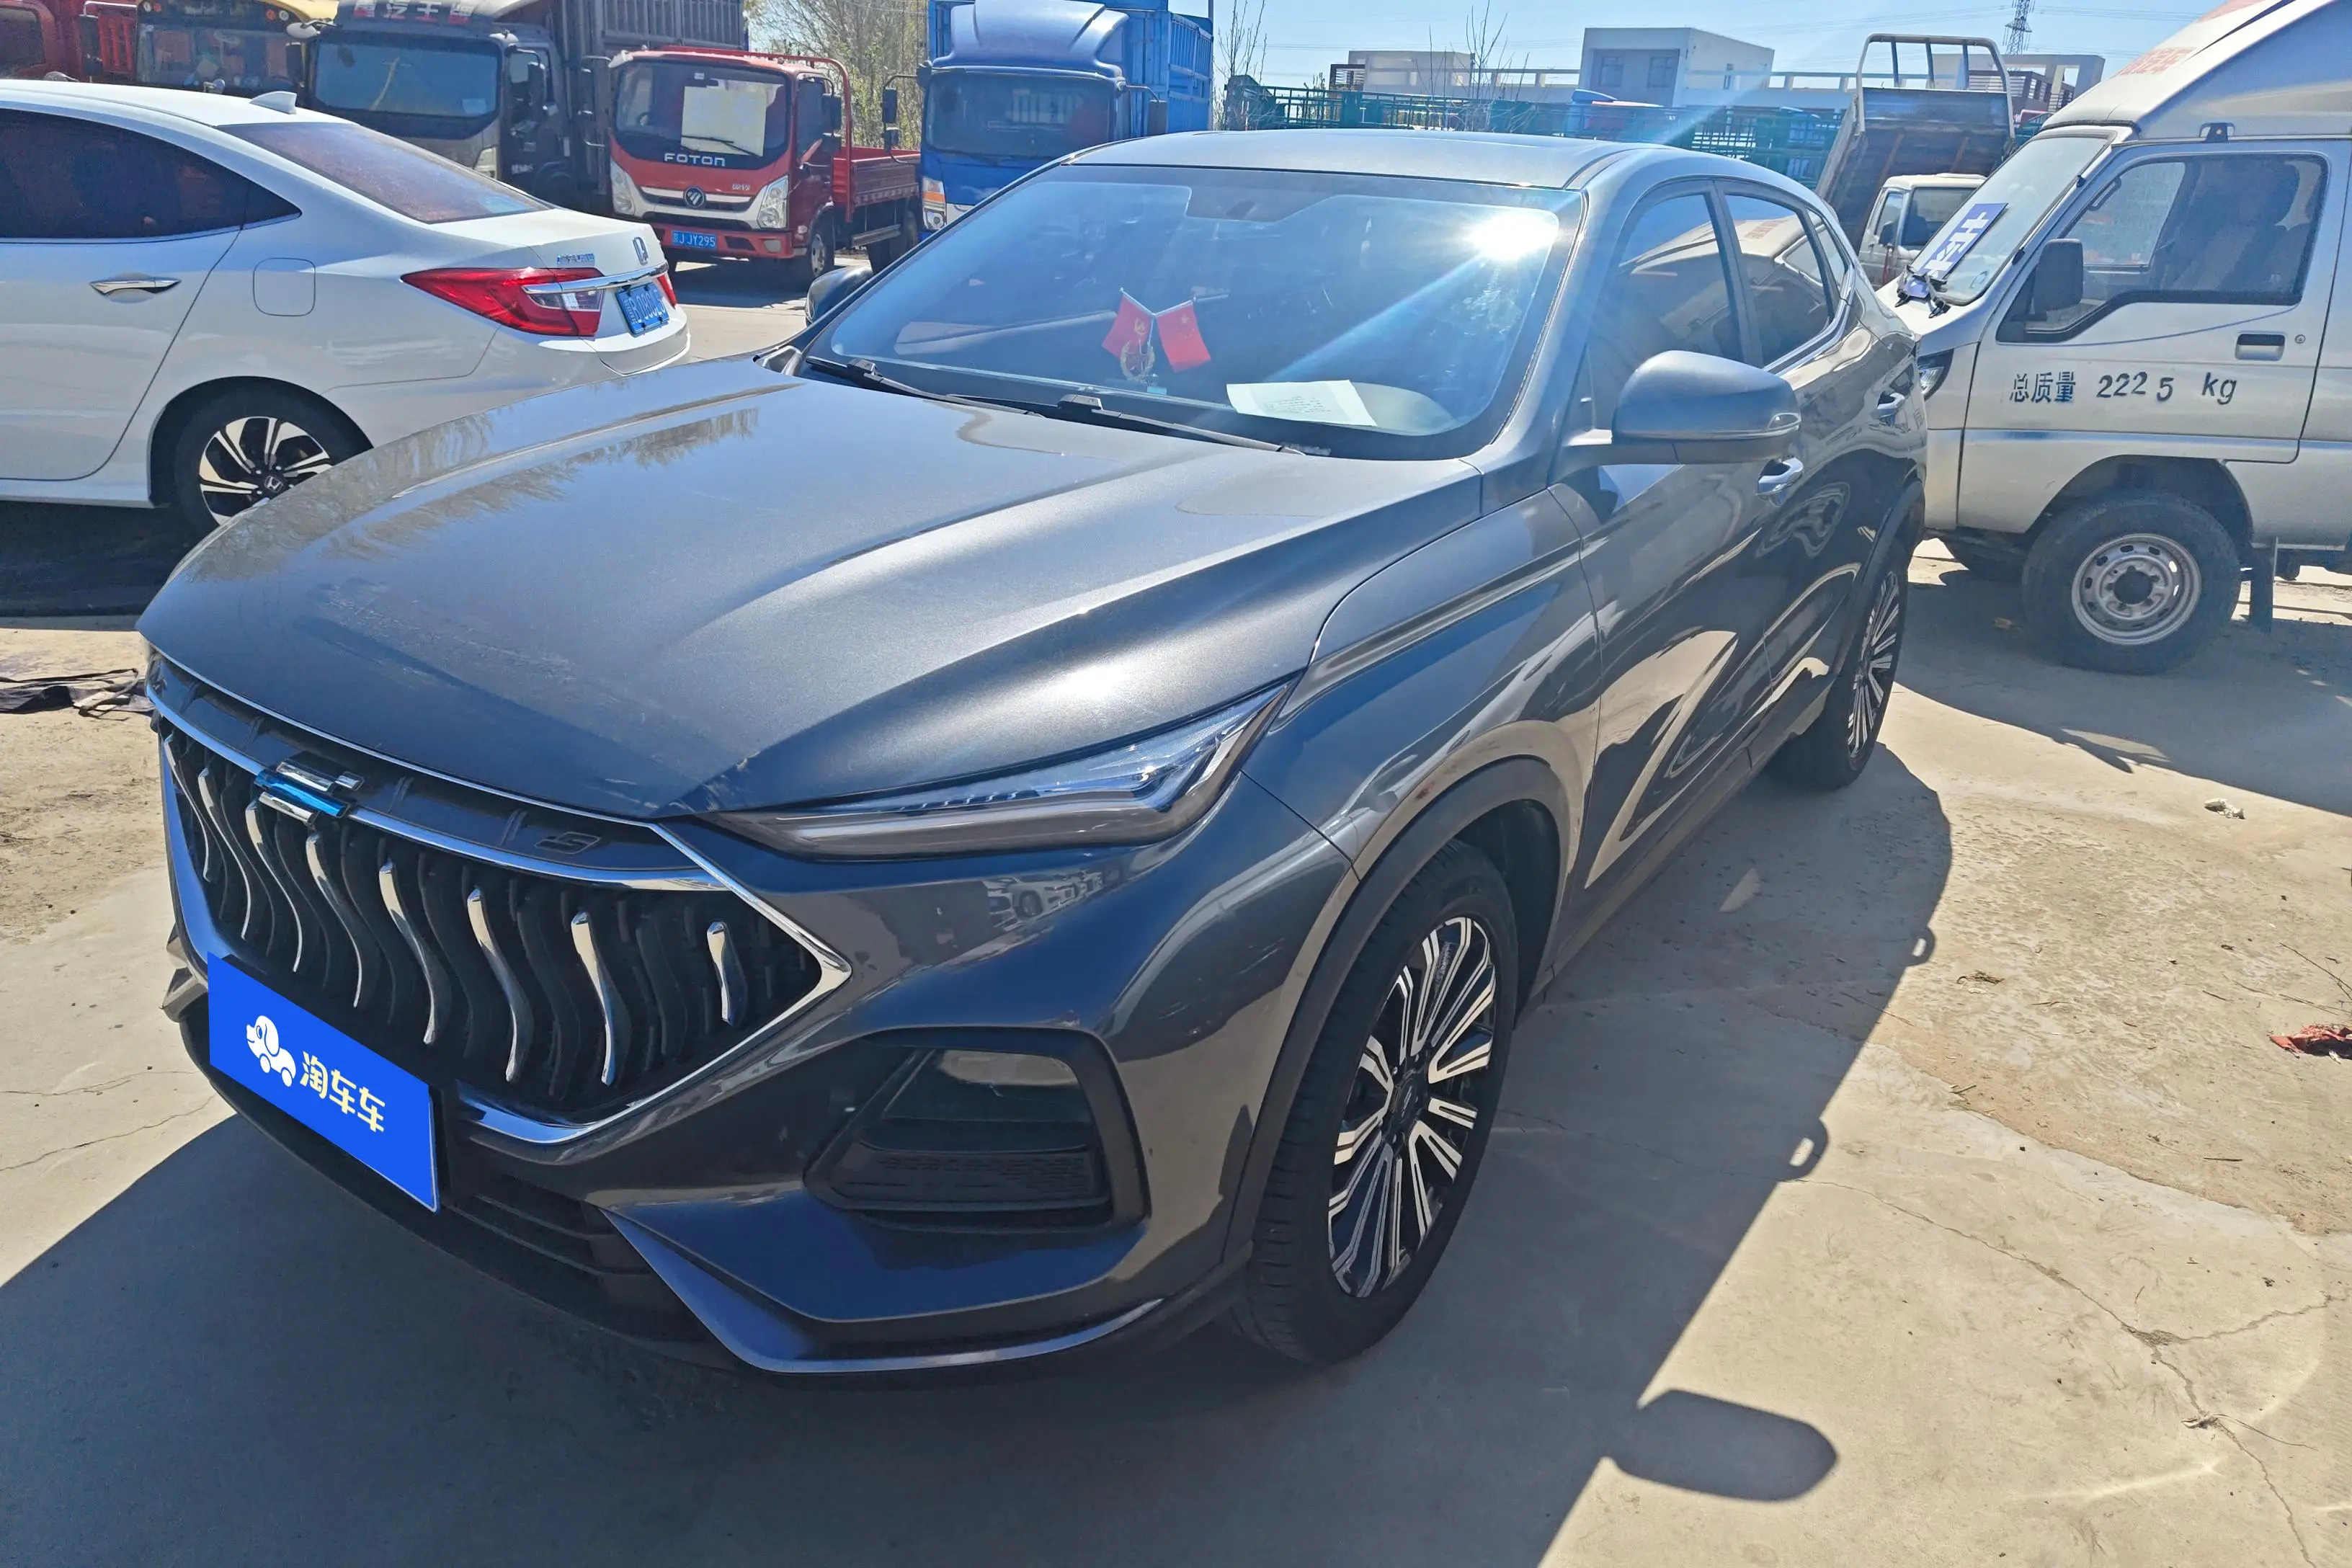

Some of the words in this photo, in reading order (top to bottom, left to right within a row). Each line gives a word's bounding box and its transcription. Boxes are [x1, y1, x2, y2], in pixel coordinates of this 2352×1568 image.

[664, 152, 726, 166] FOTON
[2010, 371, 2076, 403] 总质量
[2201, 372, 2237, 405] kg
